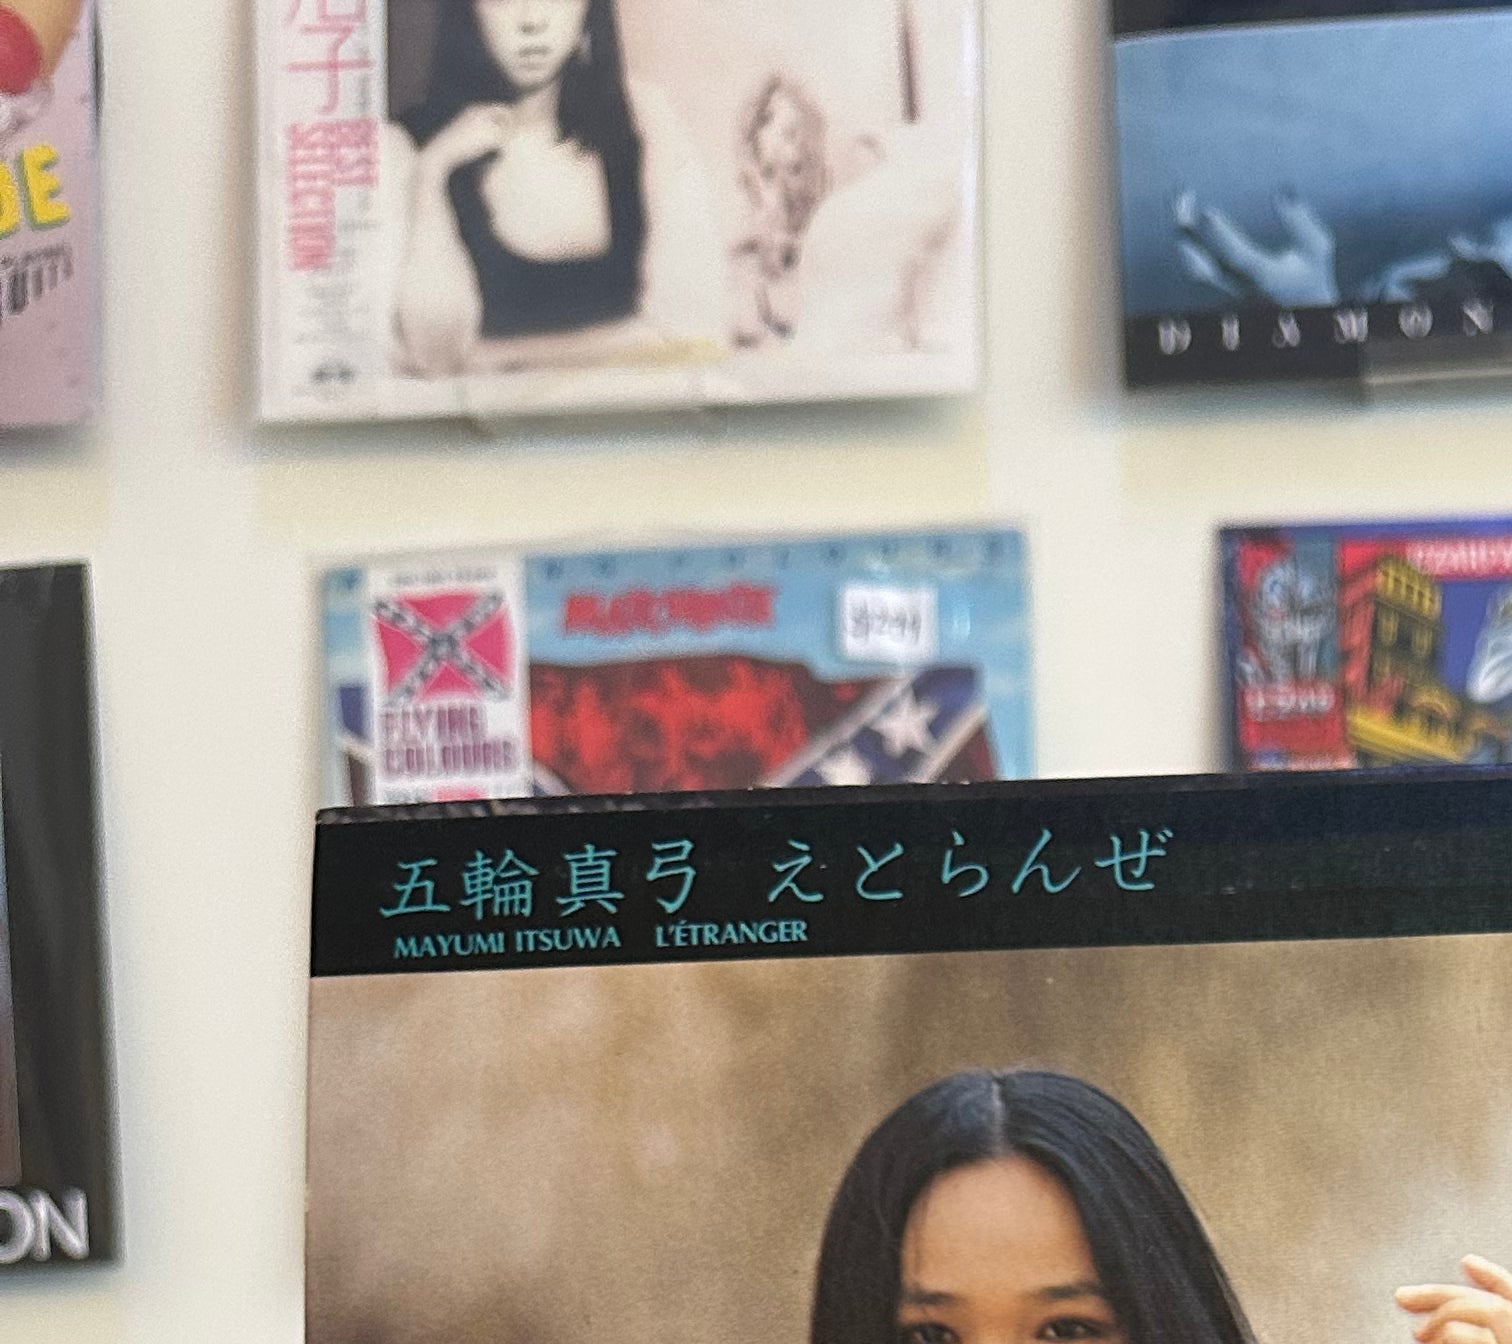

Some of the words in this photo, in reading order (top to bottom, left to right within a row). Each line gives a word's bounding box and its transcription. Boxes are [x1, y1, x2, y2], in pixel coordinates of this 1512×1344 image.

[380, 839, 696, 924] 五輪真弓
[768, 828, 1174, 902] えとらんぜ
[394, 932, 505, 958] MAYUMI
[515, 926, 621, 952] ITSUWA
[655, 919, 808, 947] L'ÉTRANGER
